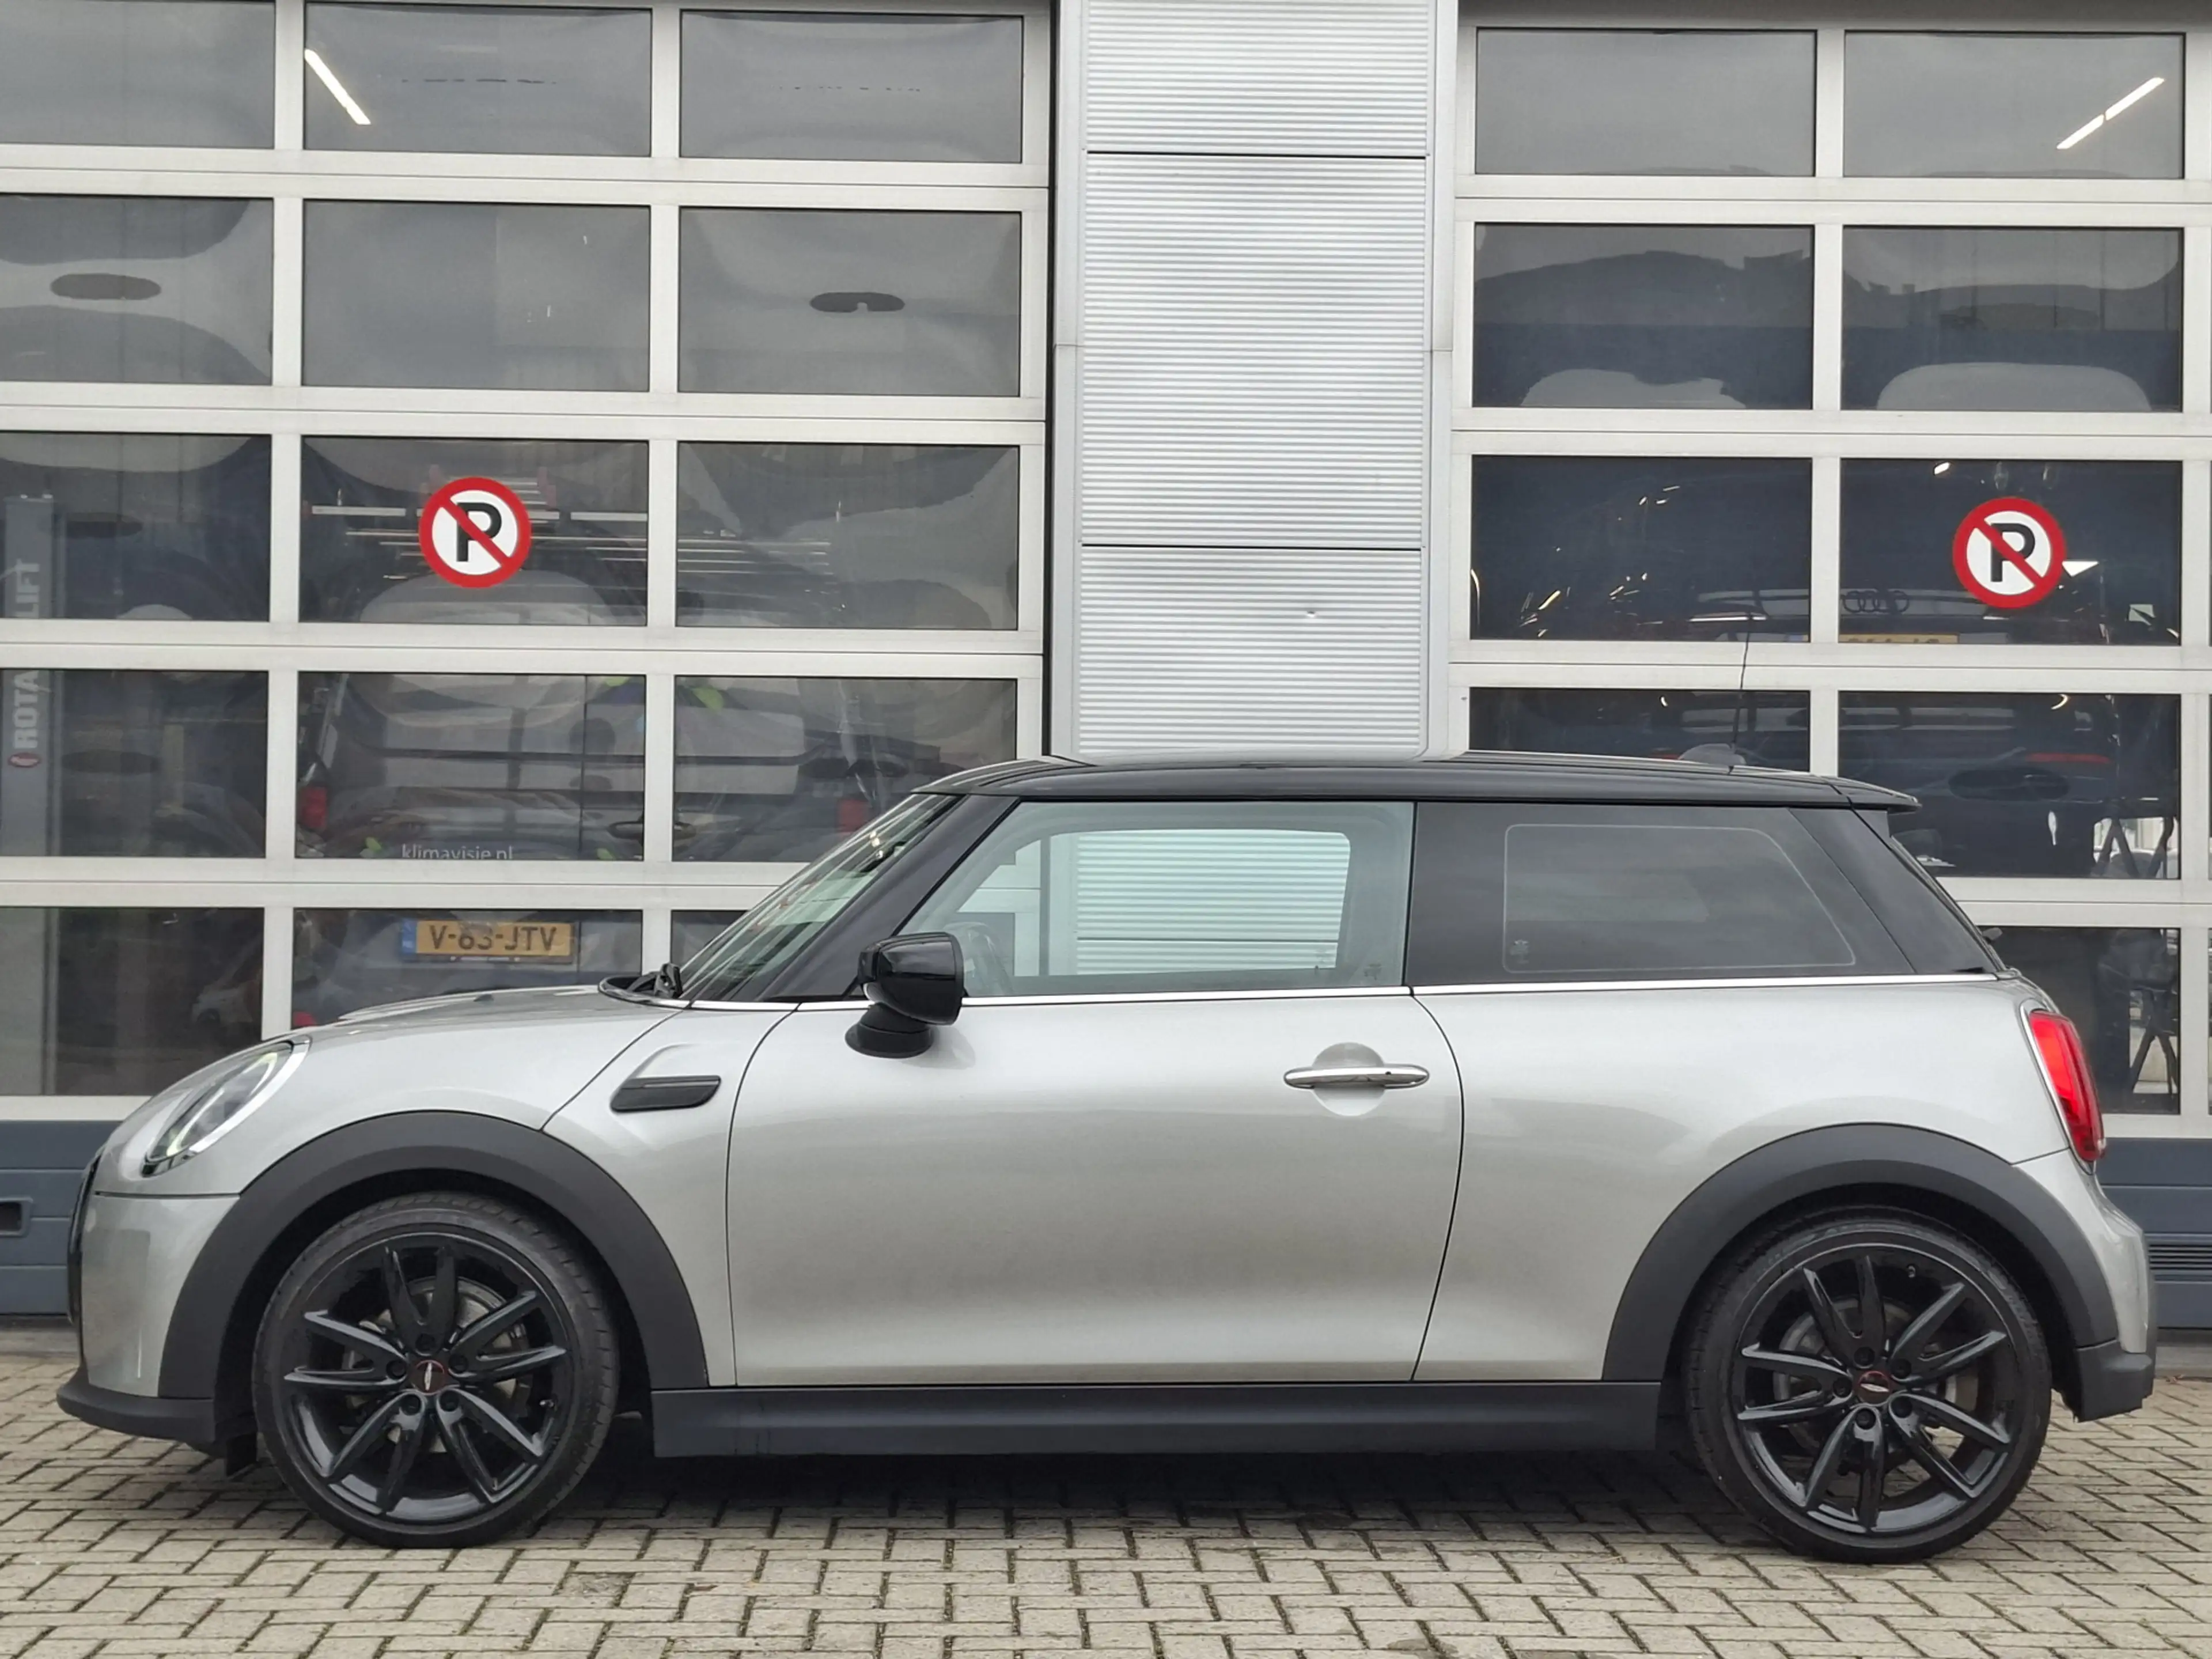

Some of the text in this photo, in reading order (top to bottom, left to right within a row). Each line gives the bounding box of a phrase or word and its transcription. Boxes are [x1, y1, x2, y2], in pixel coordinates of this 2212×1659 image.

[457, 502, 502, 562] P
[1991, 523, 2035, 582] P
[14, 558, 40, 748] ROTA LIFT
[402, 843, 513, 859] klimavisienl
